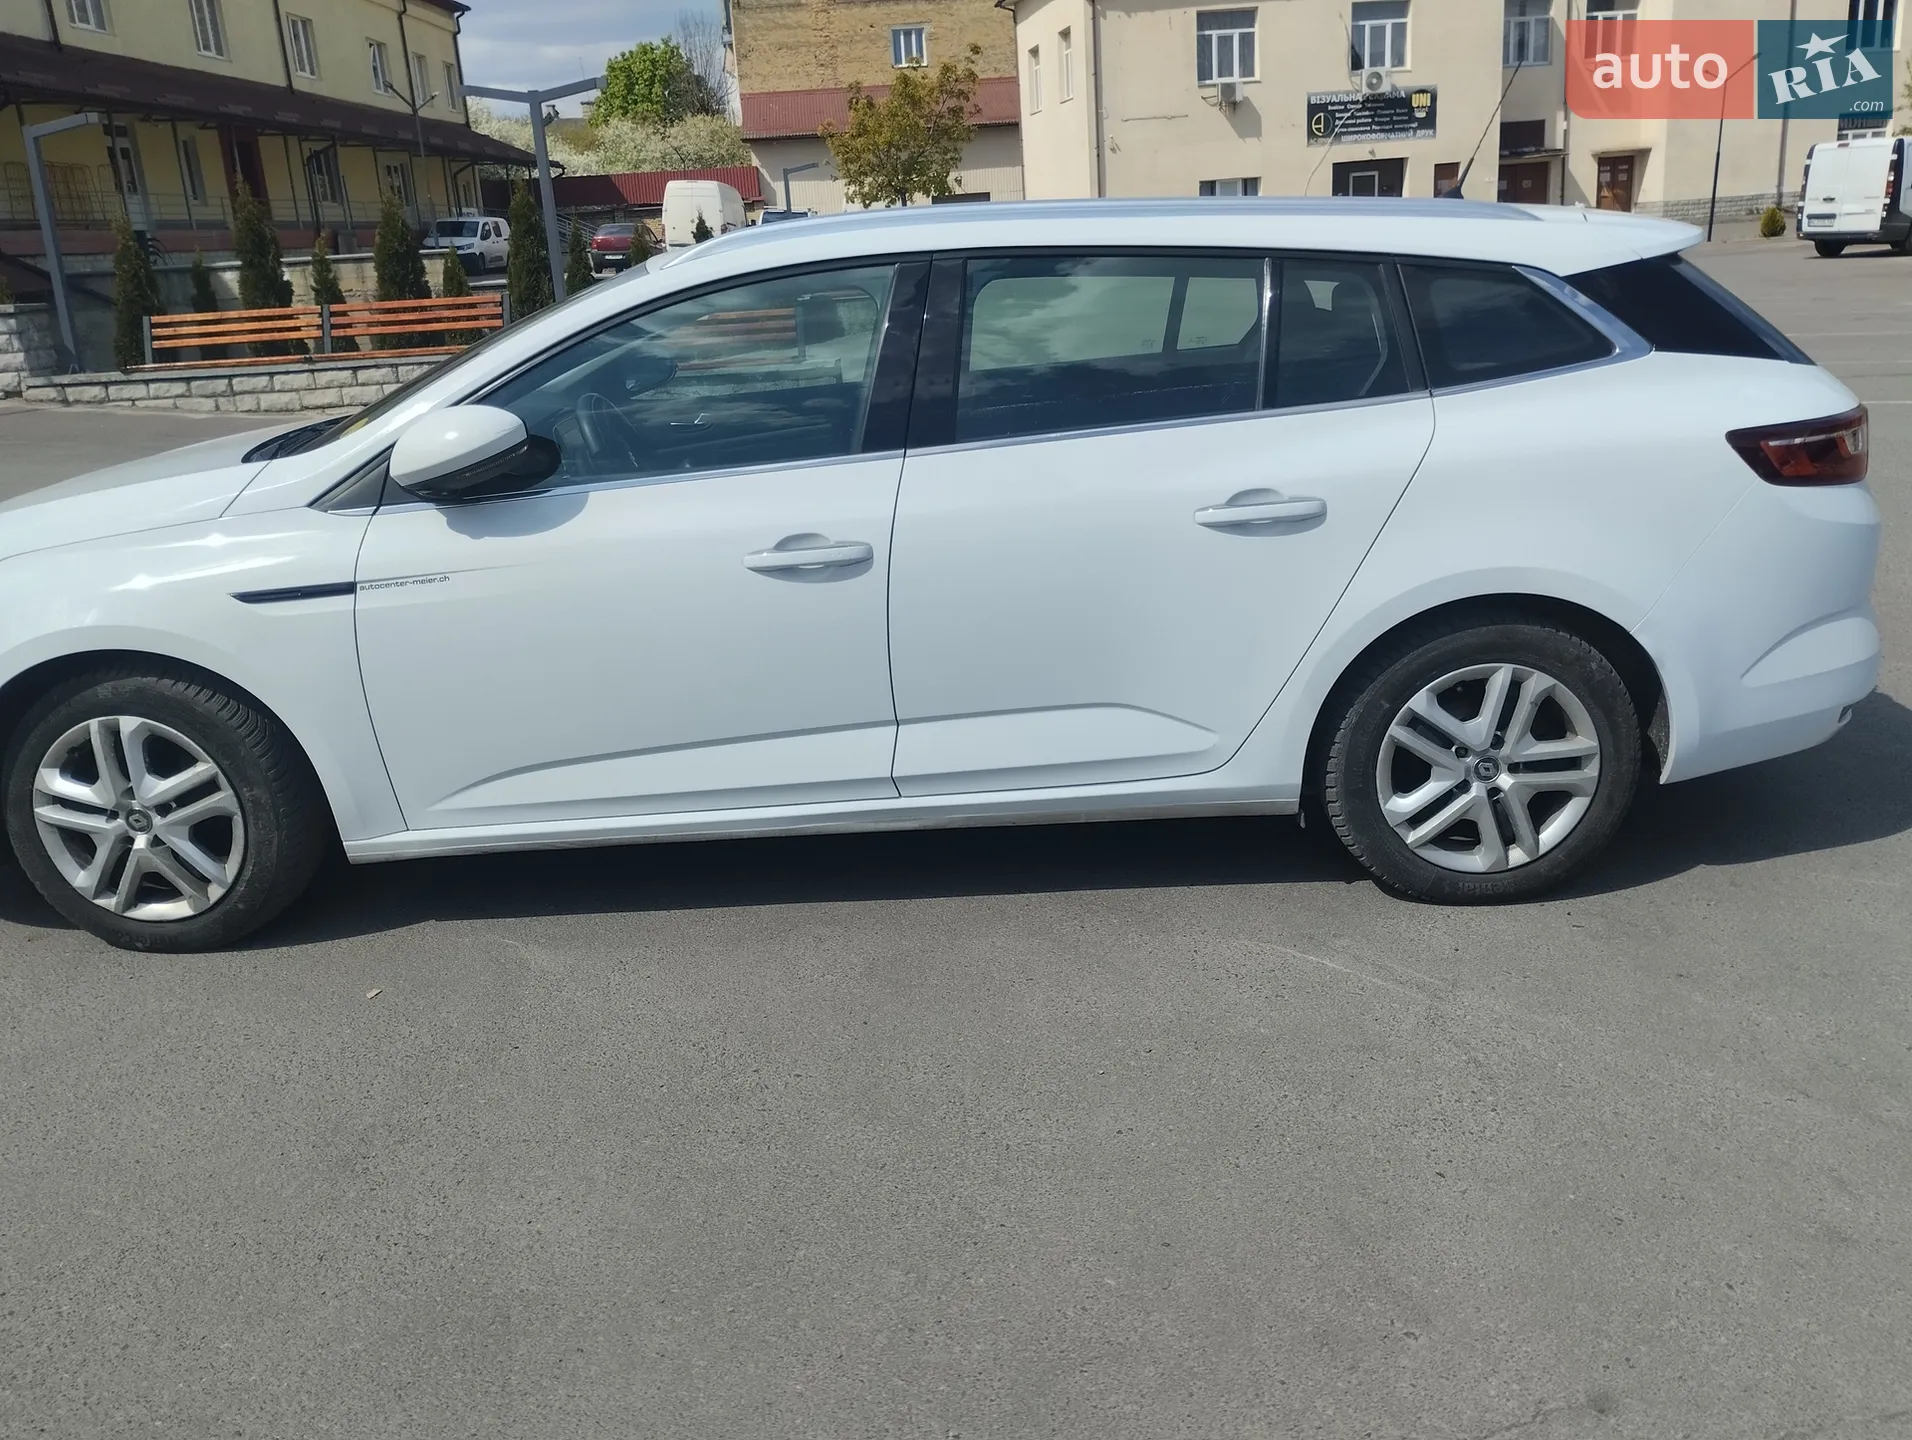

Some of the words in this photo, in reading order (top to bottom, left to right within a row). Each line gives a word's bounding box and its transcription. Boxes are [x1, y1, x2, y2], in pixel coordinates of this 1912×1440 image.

[1310, 93, 1362, 104] ВІЗУАЛЬНА
[1411, 92, 1431, 108] UNI
[1415, 129, 1434, 138] ДРУК
[359, 575, 450, 592] autocenter-meier.ch
